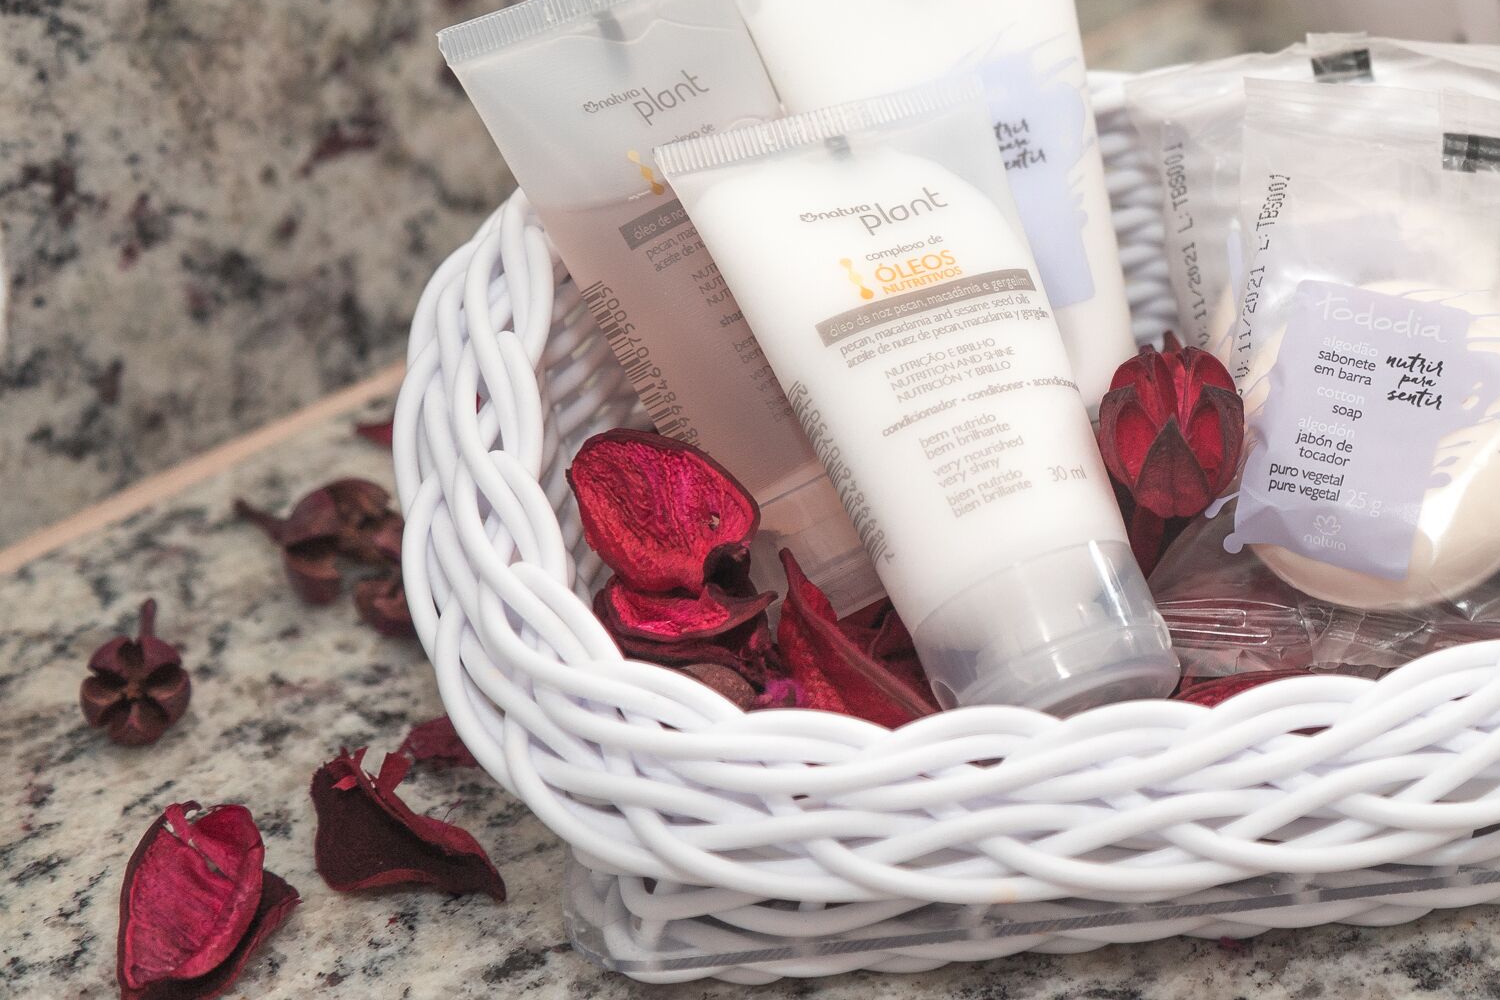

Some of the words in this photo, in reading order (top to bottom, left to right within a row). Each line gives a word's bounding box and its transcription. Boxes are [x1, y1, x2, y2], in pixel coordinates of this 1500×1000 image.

[598, 88, 641, 110] natura
[633, 69, 710, 126] plant
[994, 118, 1030, 142] trir
[1004, 148, 1047, 171] entir
[633, 223, 657, 240] óleo
[658, 214, 671, 227] de
[671, 209, 685, 222] no
[818, 203, 872, 220] natura
[859, 186, 949, 236] plant
[654, 250, 681, 273] aceite
[682, 243, 696, 257] de
[865, 240, 925, 262] complexo
[927, 234, 944, 246] de
[874, 249, 957, 283] ÓLEOS
[881, 265, 963, 295] NUTRITIVOS
[830, 319, 854, 337] óleo
[856, 311, 871, 327] de
[872, 308, 893, 321] noz
[894, 299, 928, 317] pecan,
[927, 281, 981, 305] macadâmia
[982, 282, 991, 290] e
[840, 335, 876, 359] pecan,
[875, 315, 933, 341] macadamia
[933, 308, 953, 323] and
[953, 301, 991, 317] sesame
[991, 295, 1014, 308] seed
[1016, 293, 1031, 305] oils
[846, 350, 877, 369] aceite
[877, 343, 892, 355] de
[892, 335, 918, 349] nuez
[918, 330, 931, 340] de
[963, 308, 1014, 328] macadamia
[1014, 310, 1021, 321] y
[884, 351, 946, 379] NUTRIÇÃO
[947, 348, 957, 358] E
[956, 337, 996, 356] BRILHO
[1323, 336, 1378, 357] algodão
[890, 362, 956, 392] NUTRITION
[956, 353, 983, 369] AND
[983, 345, 1016, 362] SHINE
[1314, 364, 1335, 377] em
[1338, 367, 1372, 386] barra
[1318, 350, 1376, 372] sabonete
[1386, 353, 1444, 377] nutrir
[896, 372, 963, 404] NUTRICIÓN
[963, 368, 974, 379] Y
[974, 360, 1012, 377] BRILLO
[1316, 386, 1366, 405] cotton
[1397, 374, 1437, 389] para
[882, 398, 958, 438] condicionador
[967, 379, 1025, 401] conditioner
[1332, 404, 1363, 421] soap
[1387, 388, 1443, 411] sentir
[918, 429, 950, 449] bem
[952, 412, 997, 435] nutrido
[923, 441, 955, 460] bem
[956, 422, 1011, 448] brilhante
[1295, 430, 1332, 448] jabón
[1336, 439, 1353, 453] de
[1298, 416, 1356, 439] algodón
[932, 458, 961, 477] very
[964, 435, 1025, 464] nourished
[1299, 446, 1351, 467] tocador
[938, 471, 967, 488] very
[969, 457, 1000, 475] shiny
[1047, 464, 1068, 482] 30
[1071, 464, 1088, 480] ml
[1269, 463, 1299, 477] puro
[1302, 469, 1345, 487] vegetal
[945, 488, 976, 507] bien
[977, 469, 1023, 494] nutrido
[951, 499, 981, 519] bien
[982, 479, 1033, 505] brillante
[1268, 479, 1296, 493] pure
[1299, 484, 1341, 501] vegetal
[1345, 489, 1369, 509] 25
[1370, 500, 1382, 518] g
[1303, 534, 1347, 551] natura
